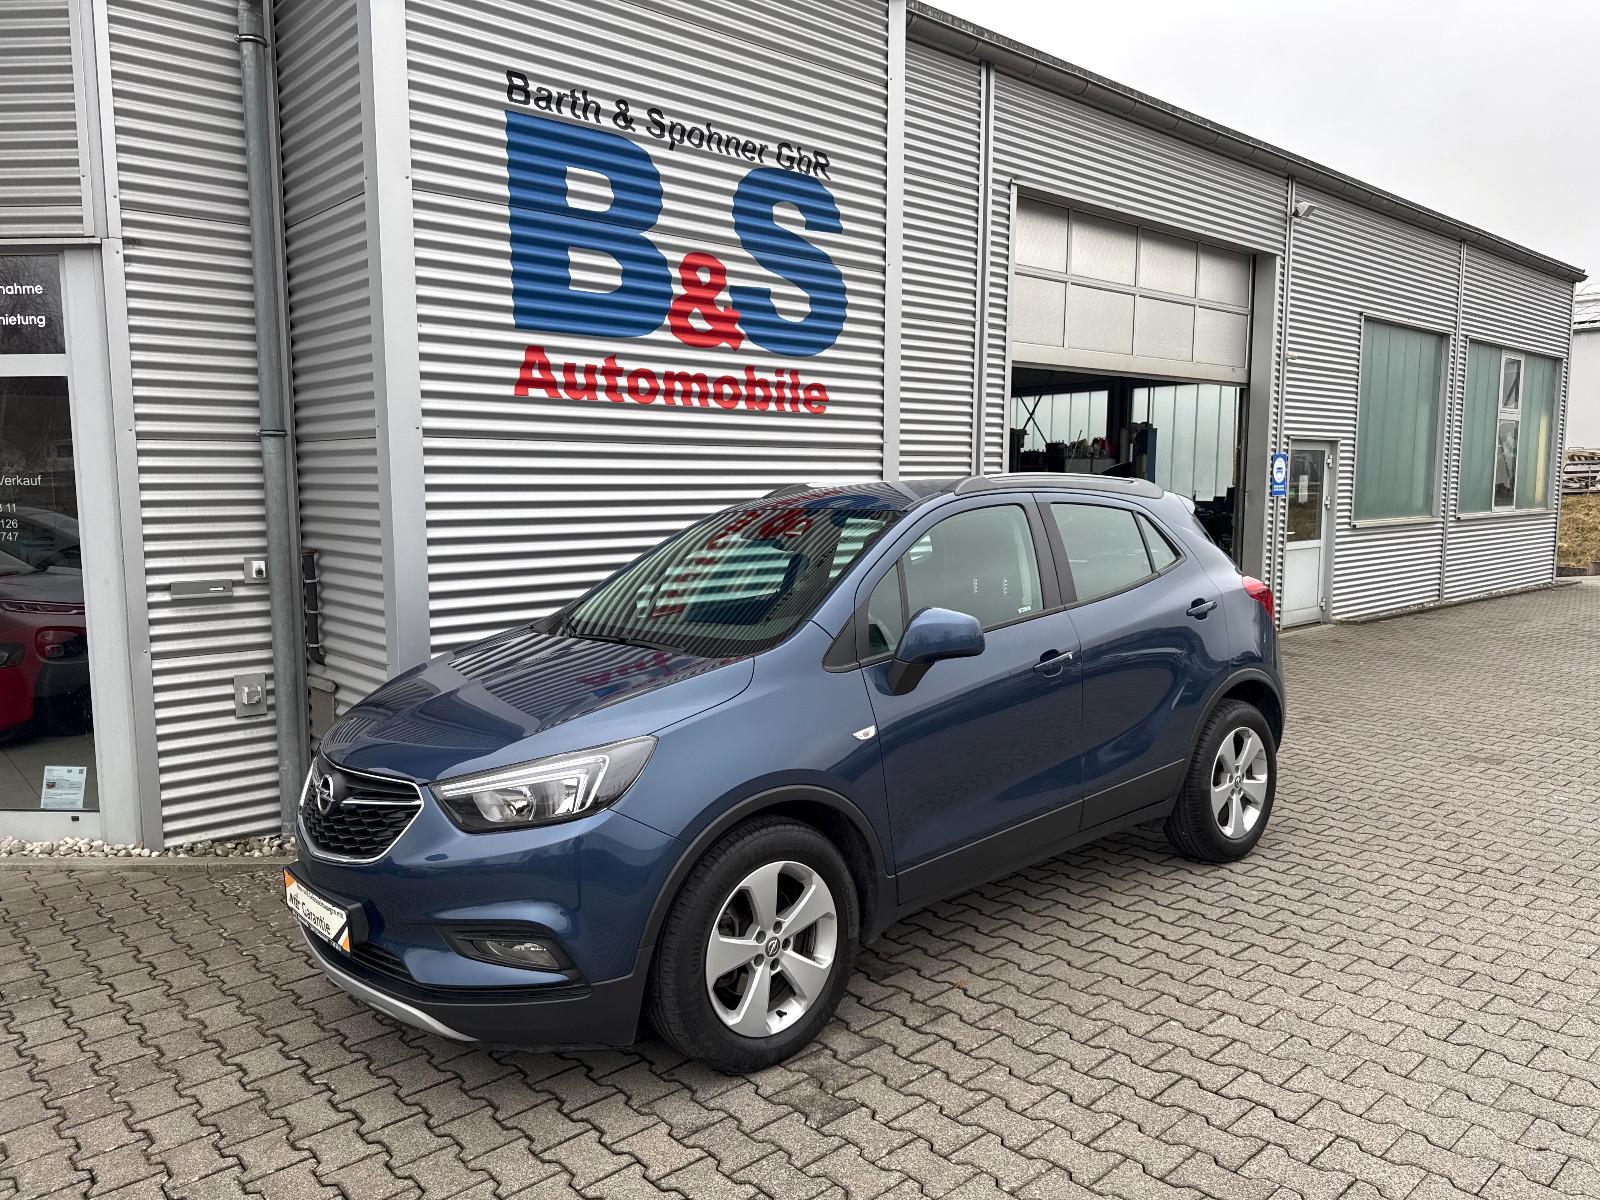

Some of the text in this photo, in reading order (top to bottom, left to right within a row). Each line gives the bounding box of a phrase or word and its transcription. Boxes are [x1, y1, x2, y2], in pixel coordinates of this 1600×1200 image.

[506, 70, 832, 180] Barth & Spohner GbR
[505, 110, 848, 357] B&S
[514, 345, 830, 414] Automobile
